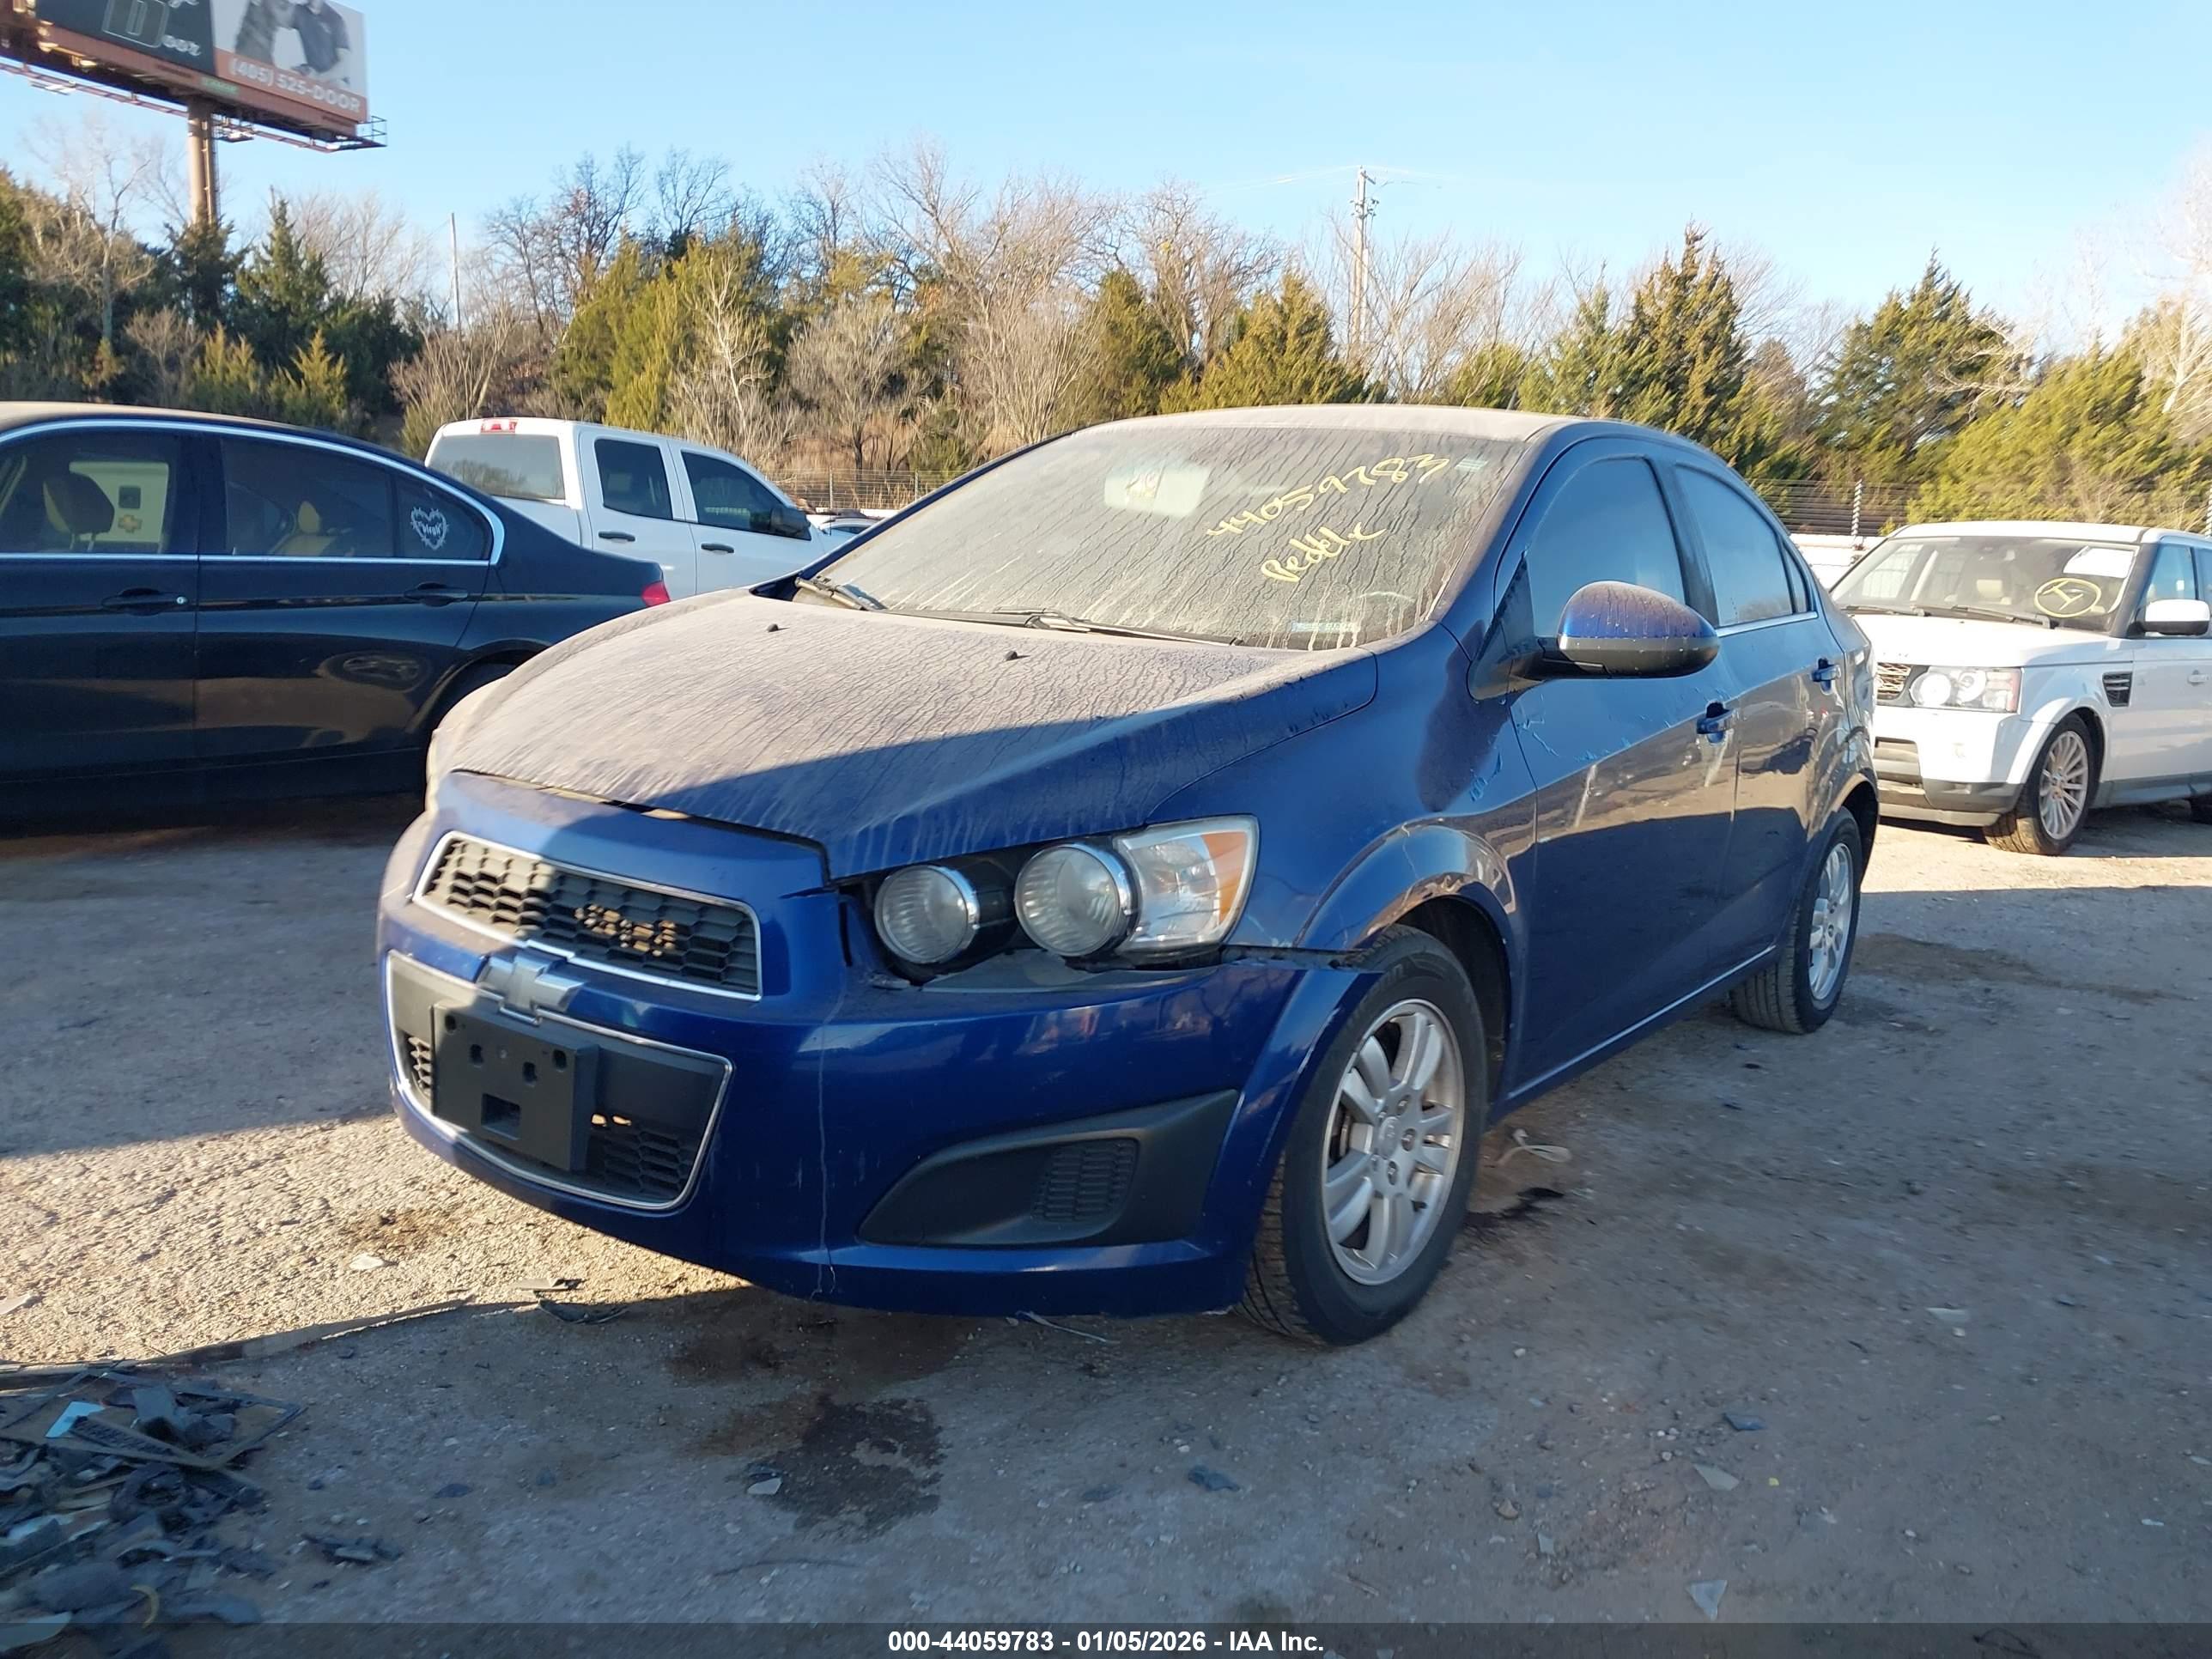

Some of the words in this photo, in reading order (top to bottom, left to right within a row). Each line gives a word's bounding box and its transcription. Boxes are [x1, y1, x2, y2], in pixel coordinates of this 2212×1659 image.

[231, 58, 274, 87] (405)
[276, 74, 361, 113] 525-DOOR
[1206, 453, 1450, 536] 44059783
